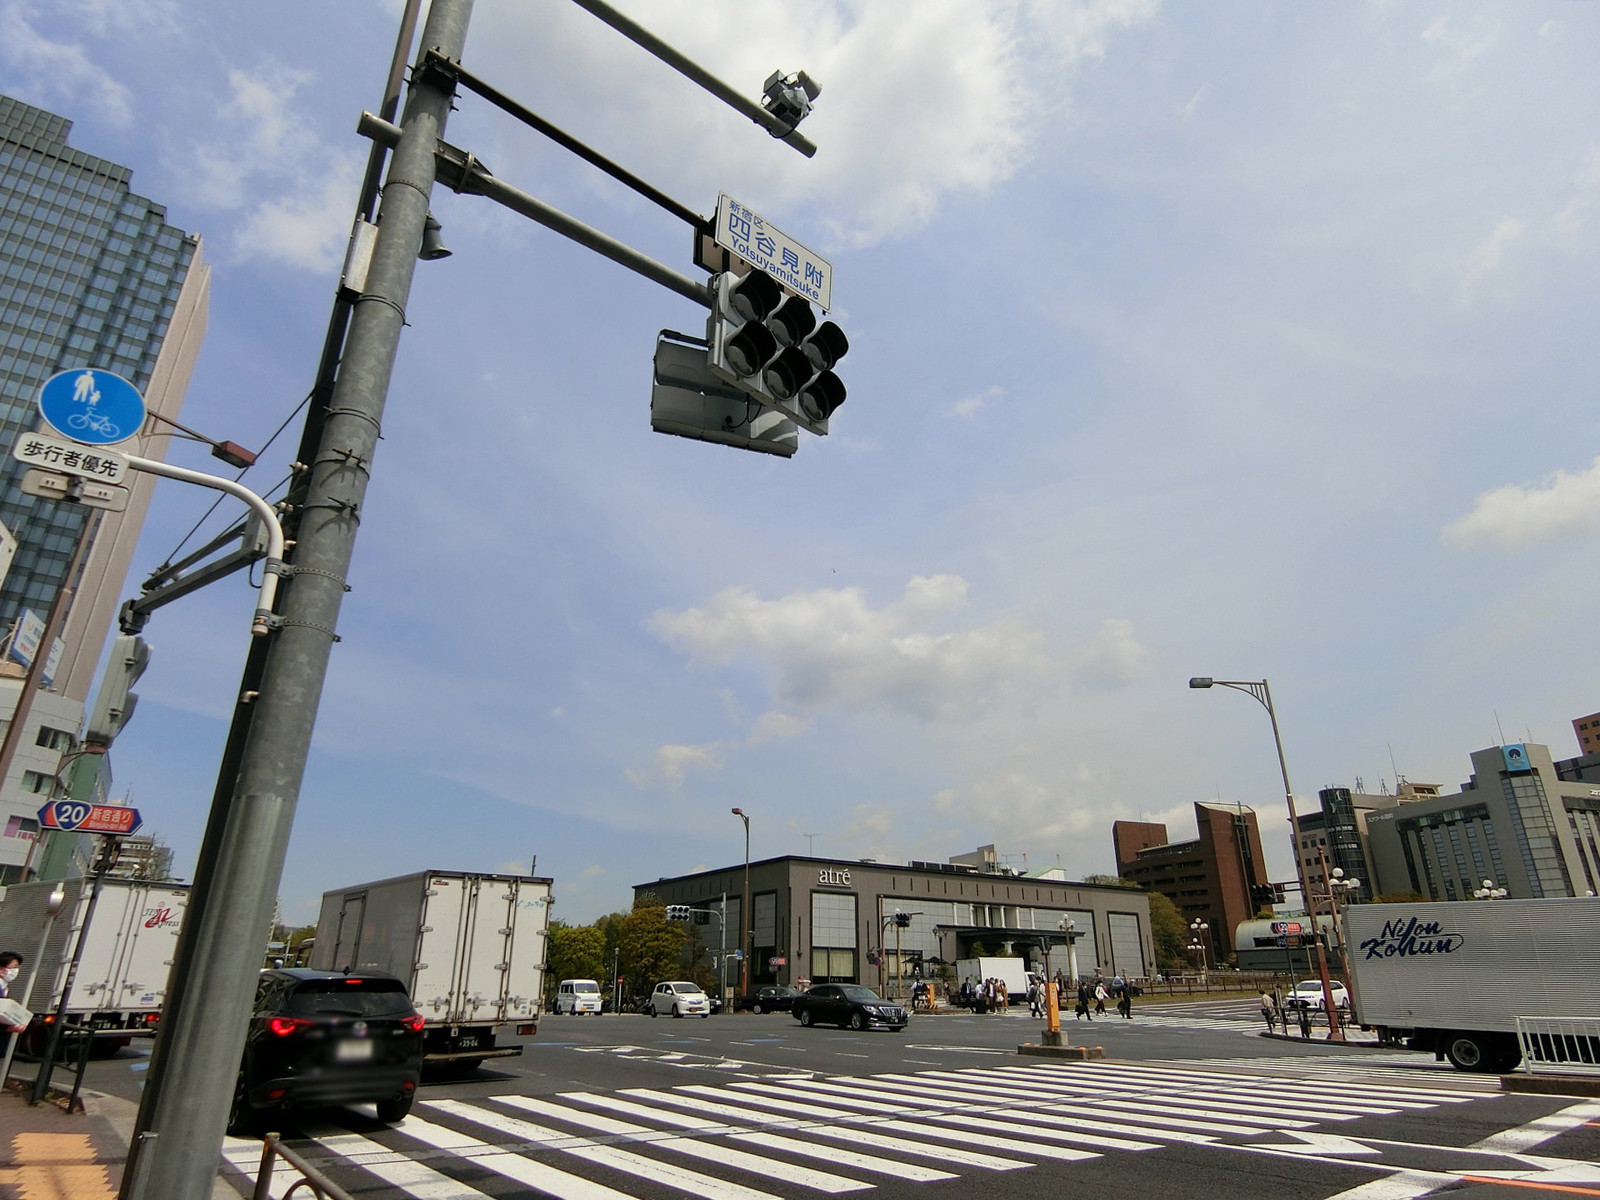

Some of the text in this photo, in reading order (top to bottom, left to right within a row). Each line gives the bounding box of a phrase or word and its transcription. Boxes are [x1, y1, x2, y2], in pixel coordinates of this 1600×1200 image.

[728, 200, 764, 230] 新宿区
[728, 213, 824, 289] 四谷見附
[731, 235, 819, 300] Yotsuyamitsuke
[23, 440, 119, 477] 歩行者優先
[58, 804, 85, 823] 20
[819, 866, 851, 885] atré
